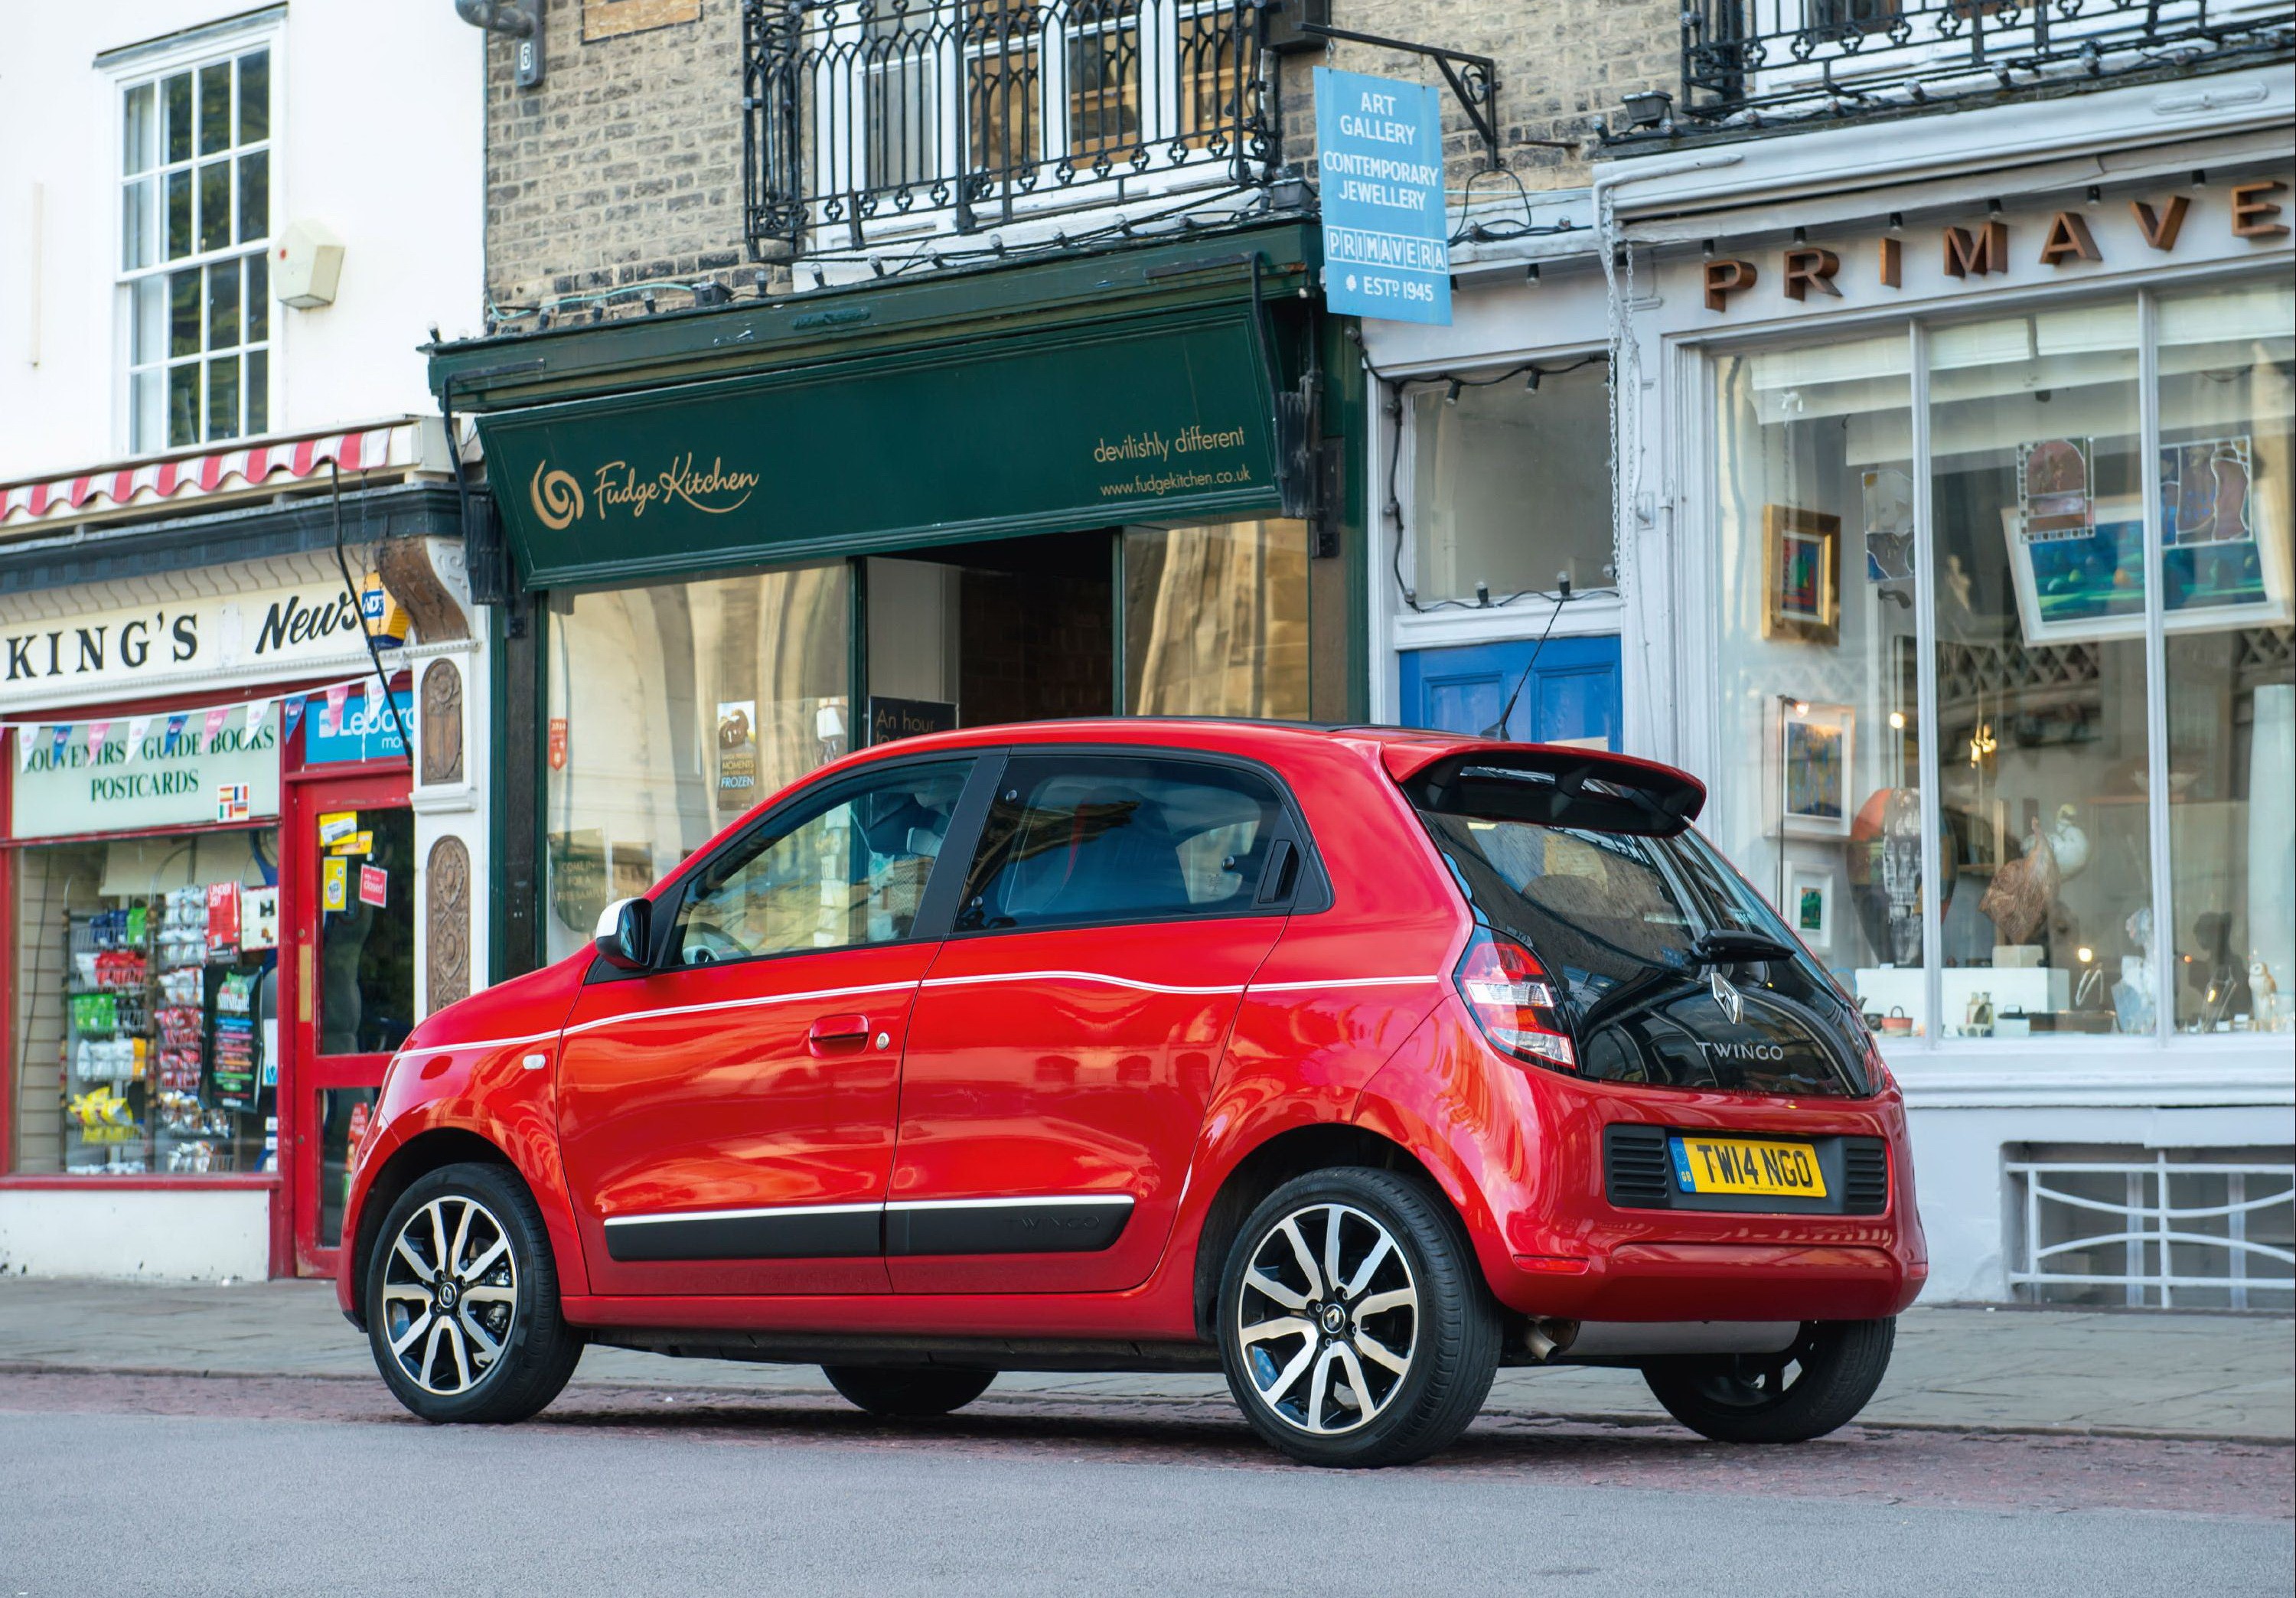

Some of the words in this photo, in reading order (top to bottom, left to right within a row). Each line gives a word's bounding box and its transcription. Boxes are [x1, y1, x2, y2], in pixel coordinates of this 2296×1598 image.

[1361, 92, 1396, 116] ART
[1340, 115, 1416, 145] GALLERY
[1323, 151, 1438, 187] CONTEMPORARY
[1339, 180, 1426, 210] JEWELLERY
[1329, 231, 1446, 269] PRIMAVERA
[1704, 181, 2290, 312] PRIMAVE
[1403, 282, 1433, 302] 1945
[1094, 431, 1170, 462] devilishly
[1175, 425, 1245, 453] different
[594, 461, 660, 520] Fudge
[660, 452, 759, 514] Kitchen
[1100, 464, 1251, 496] www.fudgekitchen.co.uk
[5, 612, 198, 680] KING'S
[255, 591, 357, 654] News
[876, 709, 897, 729] An
[903, 709, 935, 732] hour
[210, 726, 275, 755] BOOKS
[91, 769, 199, 802] POSTCARDS
[721, 775, 755, 789] FROZEN
[1697, 1041, 1784, 1061] TWINGO
[1696, 1144, 1760, 1185] TW14
[1760, 1148, 1814, 1189] NGO
